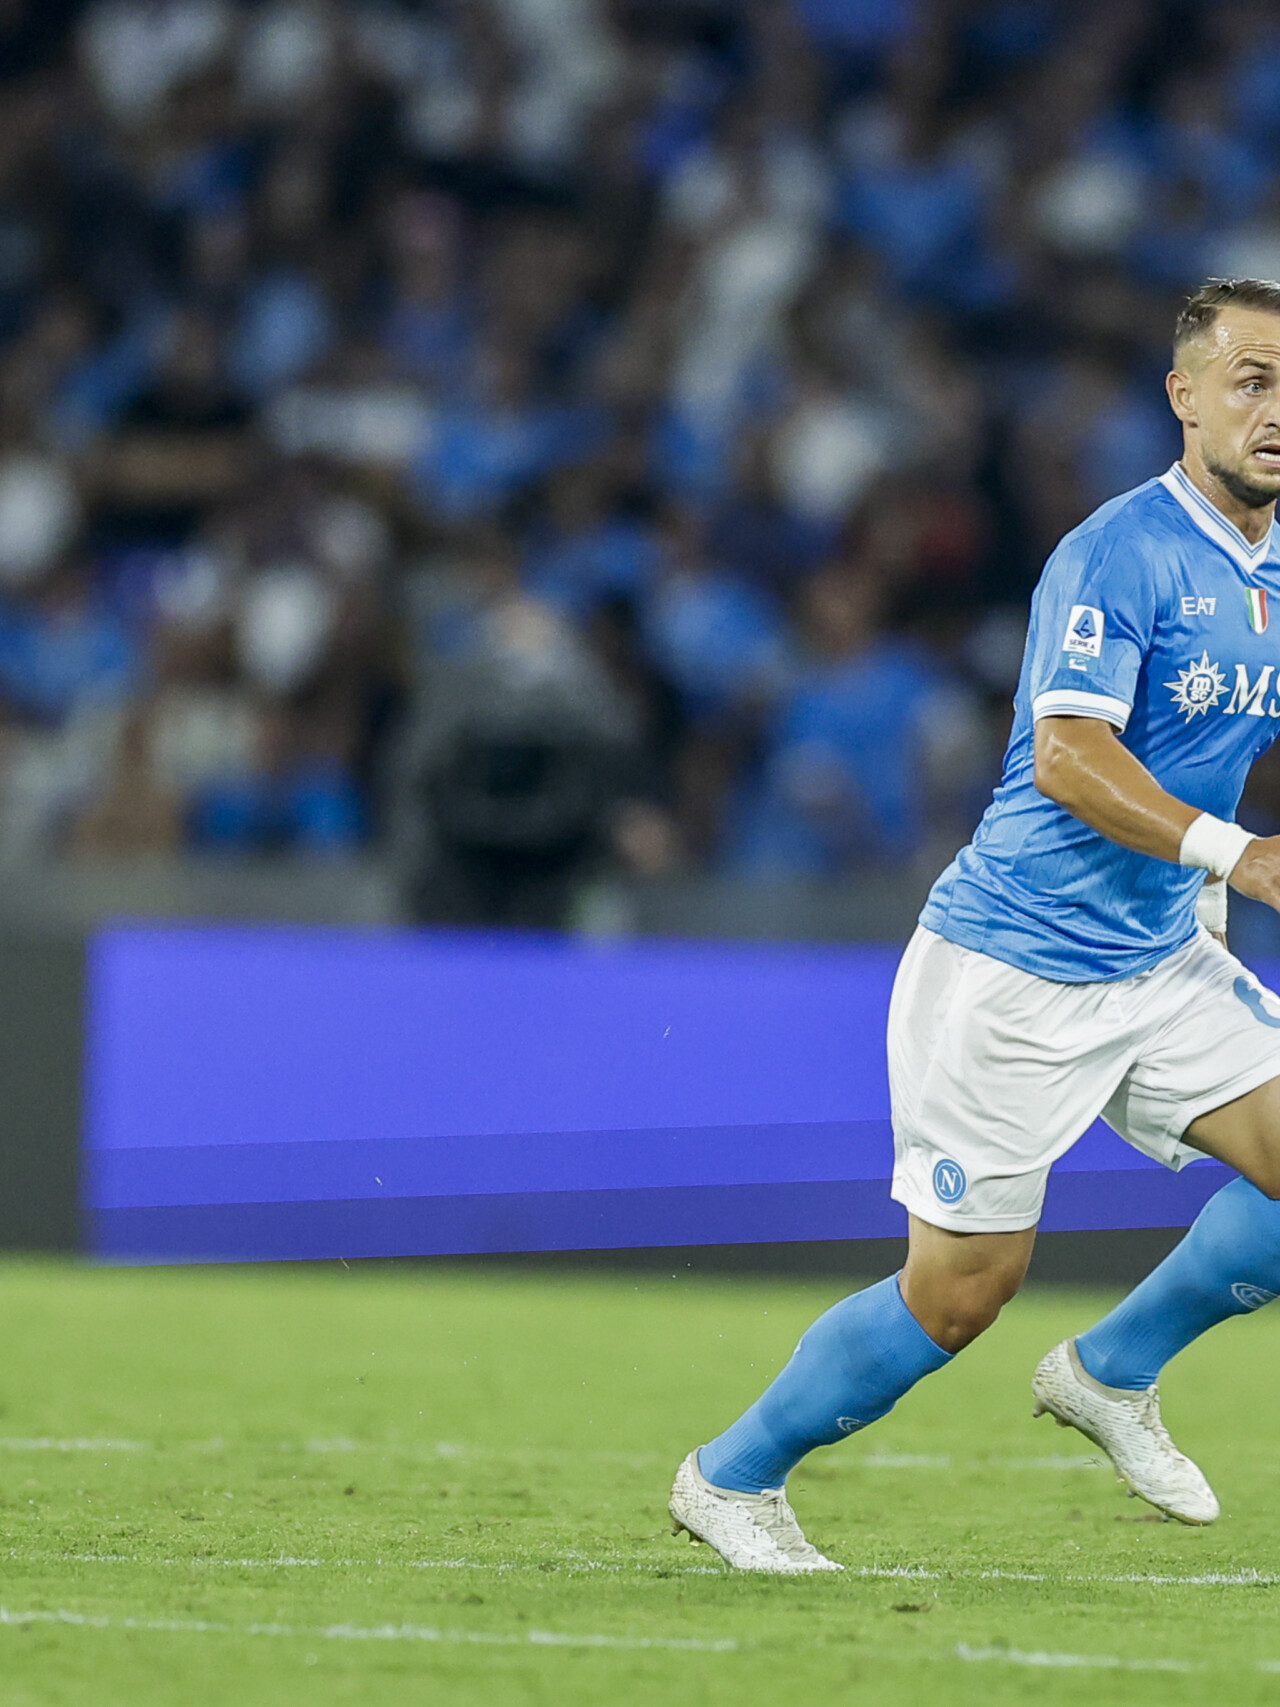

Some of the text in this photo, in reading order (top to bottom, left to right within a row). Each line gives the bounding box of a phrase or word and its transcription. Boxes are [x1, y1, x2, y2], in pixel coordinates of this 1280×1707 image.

[1181, 597, 1216, 615] EA7
[1069, 639, 1089, 648] SERIE
[940, 1168, 958, 1194] N
